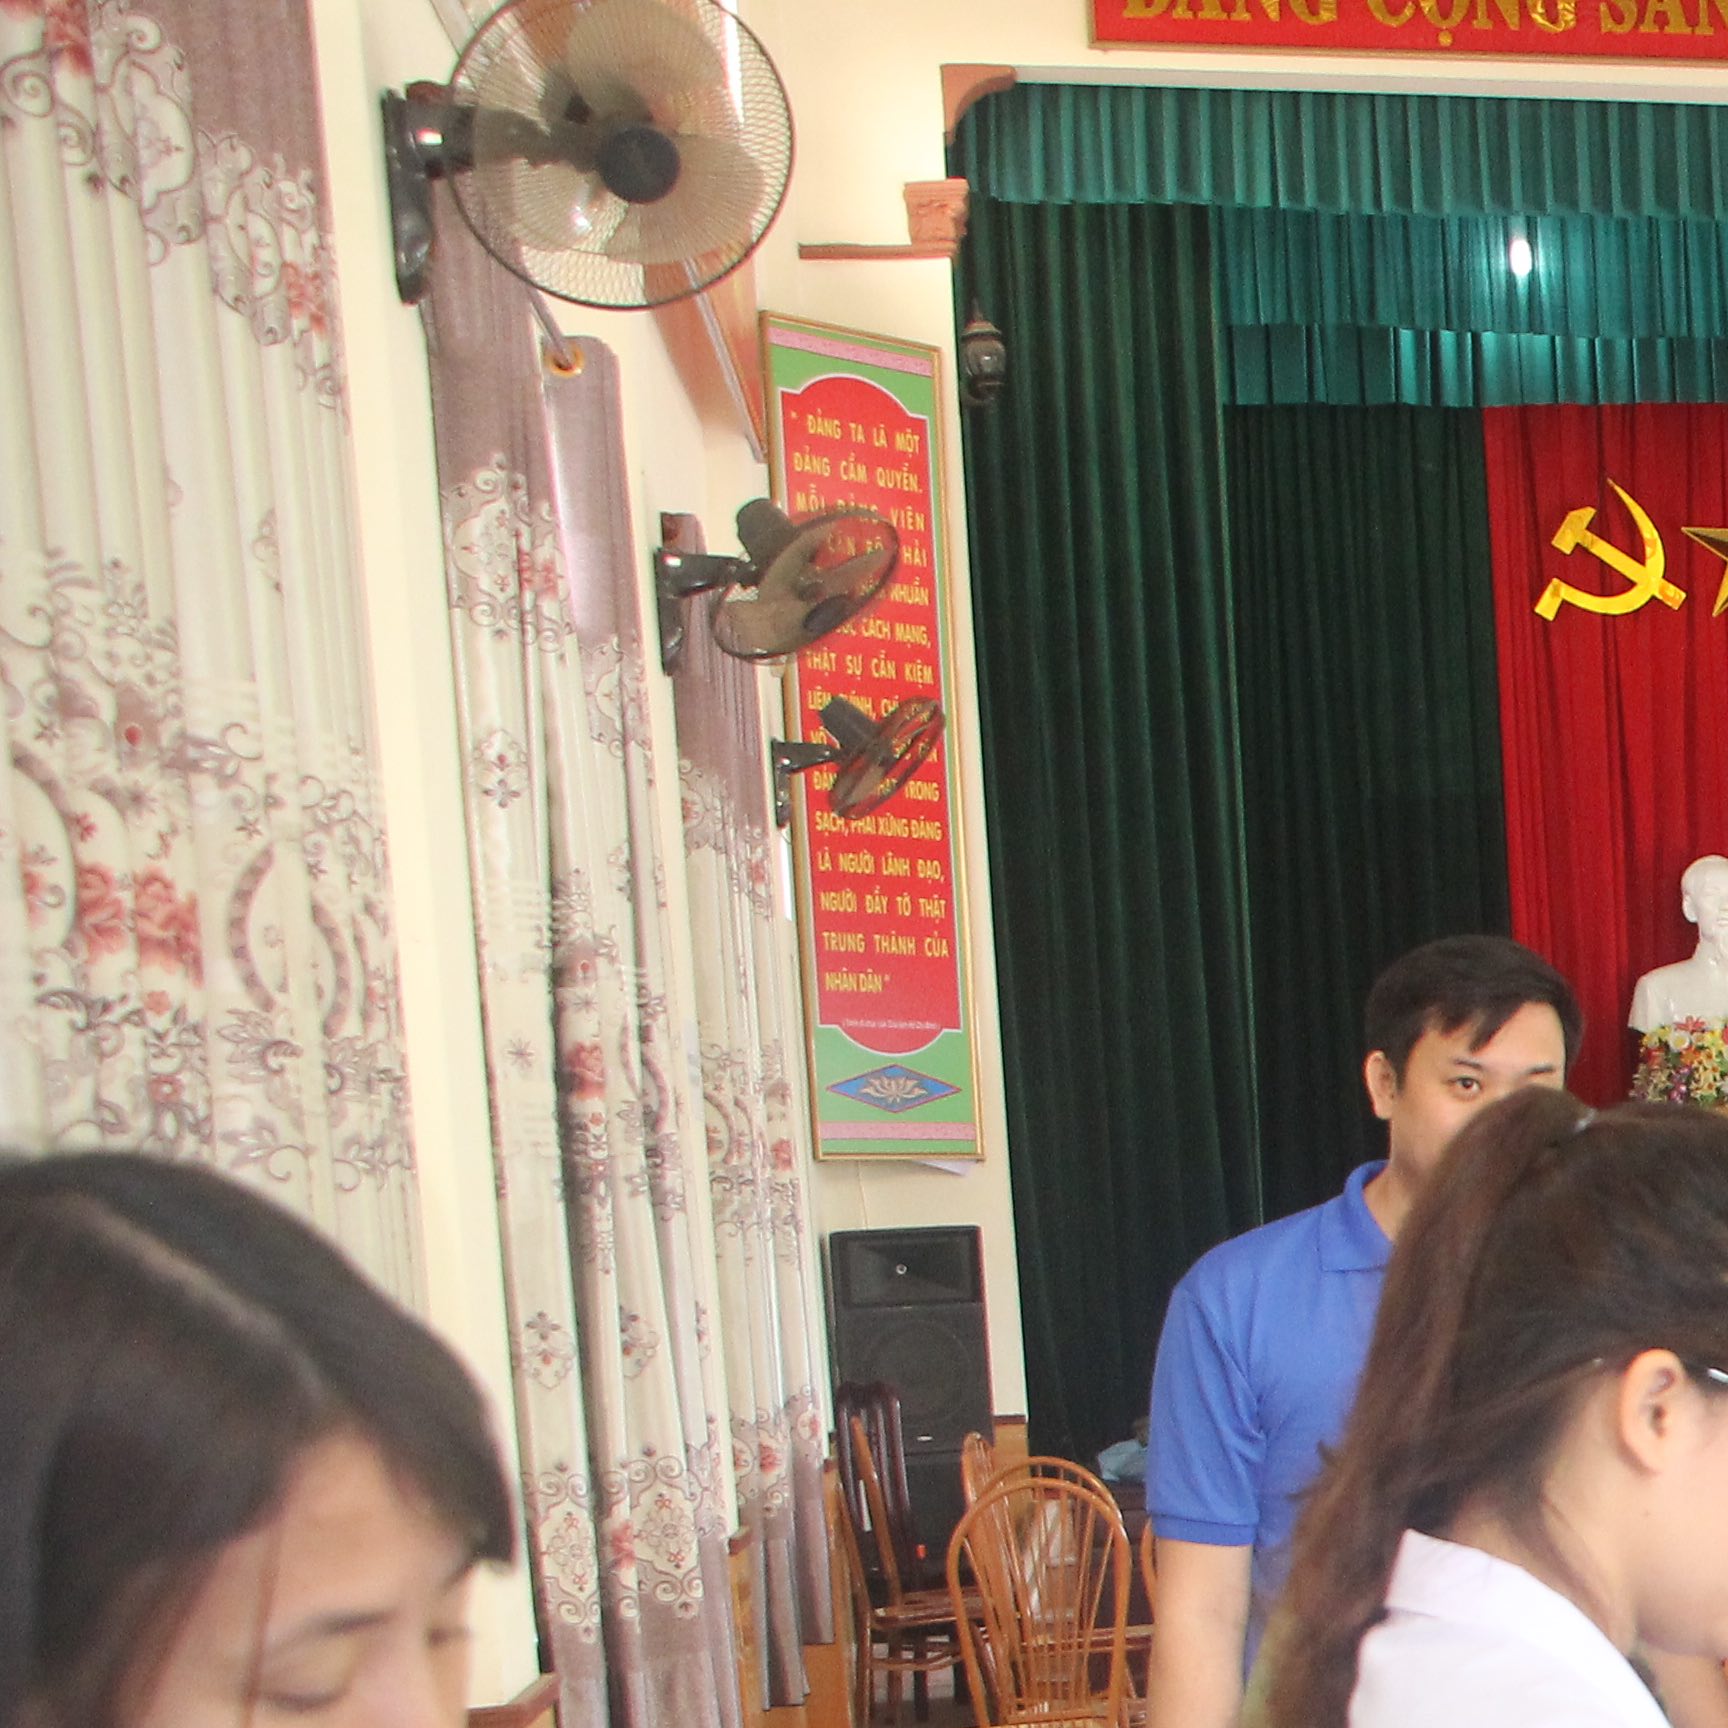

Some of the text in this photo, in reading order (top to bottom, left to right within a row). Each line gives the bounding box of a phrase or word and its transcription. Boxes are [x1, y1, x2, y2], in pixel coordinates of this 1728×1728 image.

[807, 408, 920, 458] ĐẢNG TA LÀ MỘT
[793, 445, 831, 477] ĐẢNG
[840, 452, 867, 483] CẦM
[891, 505, 925, 532] VIÊN
[902, 539, 928, 567] HẢI
[904, 659, 934, 688] KIỆM
[818, 847, 832, 872] LÀ
[839, 849, 875, 874] NGƯỜI
[820, 888, 857, 913] NGƯỜI
[919, 894, 946, 924] THẬT
[822, 930, 949, 958] TRUNG THÀNH CỦA
[825, 967, 857, 992] NHÂN
